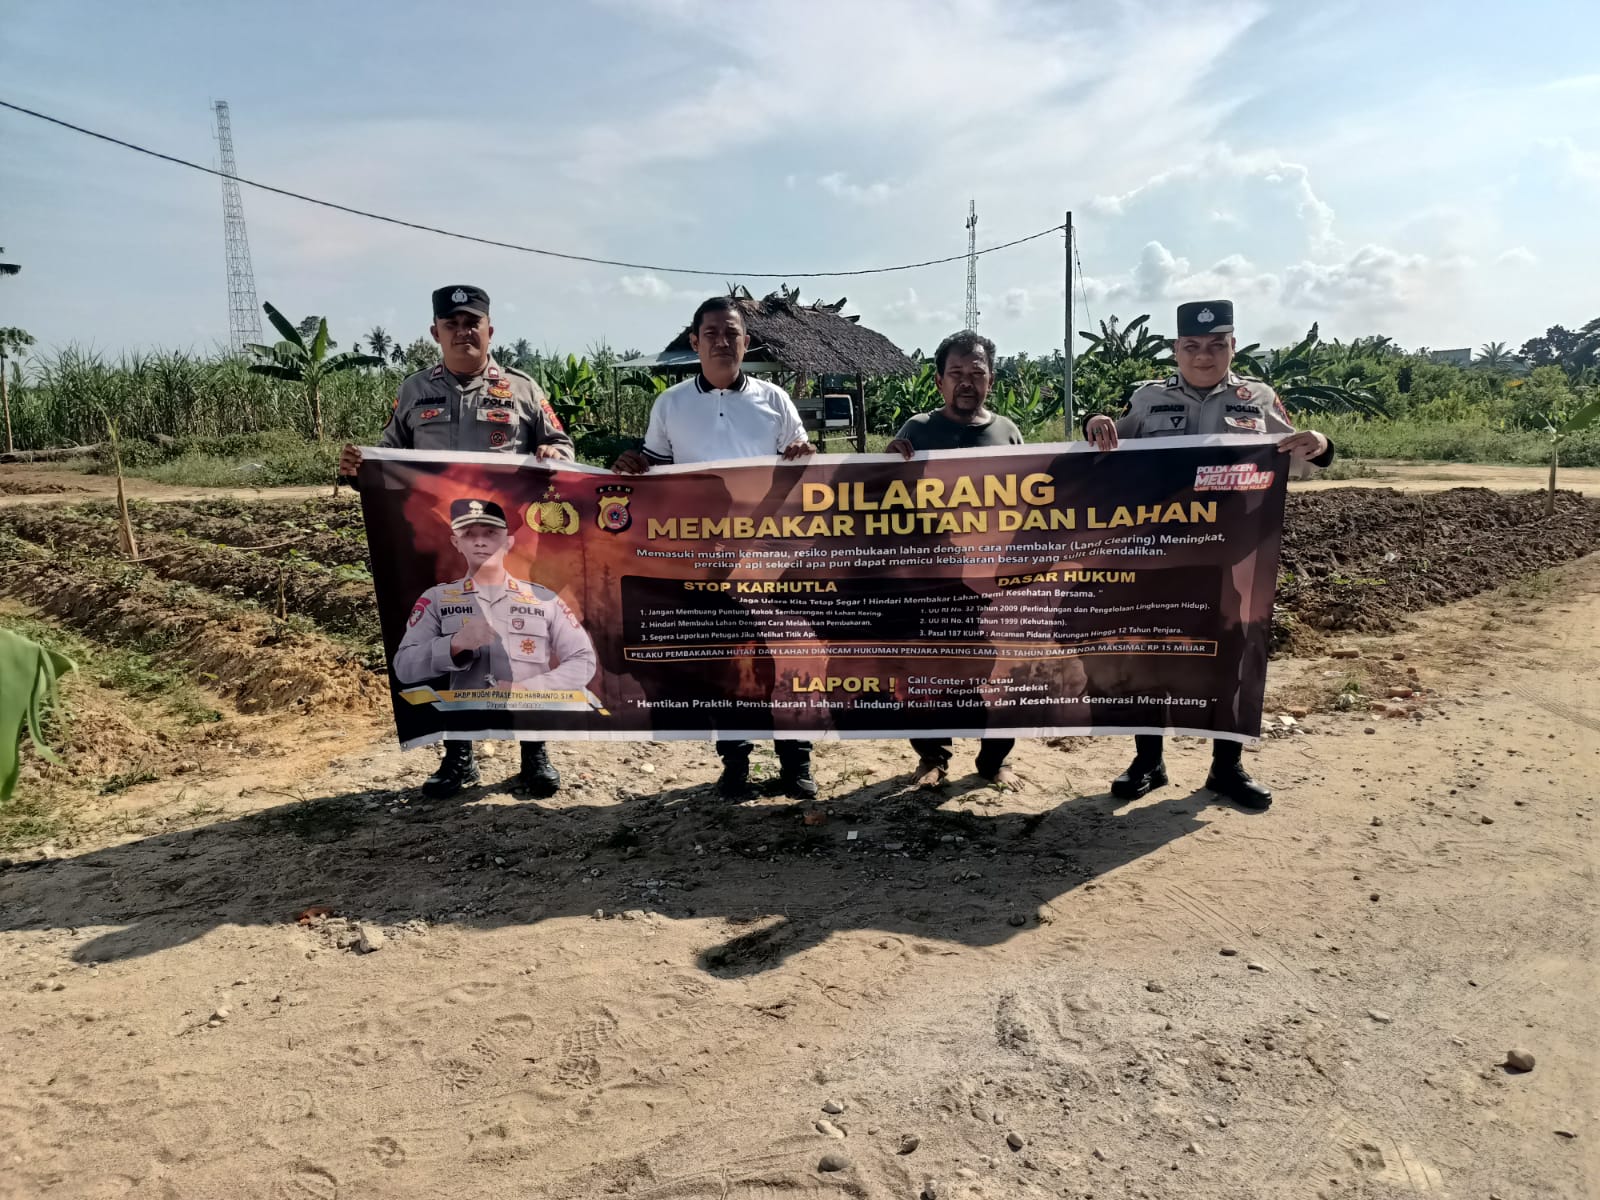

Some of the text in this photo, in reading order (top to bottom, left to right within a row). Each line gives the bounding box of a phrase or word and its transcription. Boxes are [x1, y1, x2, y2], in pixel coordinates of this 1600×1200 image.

[483, 397, 514, 409] POLRI
[1197, 465, 1227, 474] POLDA
[1194, 471, 1270, 487] MEUTUAH
[802, 472, 1056, 512] DILARANG
[647, 501, 1218, 540] MEMBAKAR HUTAN DAN LAHAN
[636, 533, 1226, 559] Memasuki musim kemarau, resiko pembukaan lahan dengan cara membakar (Land Clearing) Meningkat,
[694, 547, 1167, 569] percikan api sekecil apa pun dapat memicu kebakaran besar yang sulit dikendalikan.
[997, 571, 1136, 587] DASAR HUKUM
[683, 581, 839, 593] STOP KARHUTLA
[981, 591, 1003, 599] Demi
[1006, 588, 1051, 597] Kesehatan
[1054, 589, 1096, 598] Bersama.
[440, 606, 473, 616] MUGHI
[510, 606, 545, 617] POLRI
[1020, 605, 1072, 614] (Perlindungan
[1090, 605, 1134, 615] Pengelolaan
[1136, 602, 1180, 611] Lingkungan
[1181, 602, 1211, 611] Hidup).
[650, 633, 674, 641] Segera
[1053, 631, 1089, 639] Kurungan
[1090, 629, 1116, 637] Hingga
[1153, 626, 1183, 635] Penjara.
[631, 651, 663, 659] PELAKU
[665, 649, 724, 658] PEMBAKARAN
[727, 648, 756, 656] HUTAN
[811, 647, 852, 655] DIANCAM
[901, 647, 938, 655] PENJARA
[973, 648, 998, 656] LAMA
[1013, 649, 1044, 657] TAHUN
[1066, 646, 1096, 654] DENDA
[792, 676, 881, 693] LAPOR
[907, 676, 927, 684] Call
[930, 677, 965, 685] Center
[969, 677, 987, 685] 110
[907, 684, 1049, 695] Kantor Kepolisian Terdekat
[636, 695, 1207, 711] Hentikan Praktik Pembakaran Lahan Lindungi Kualitas Udara dan Kesehatan Generasi Mendatang
